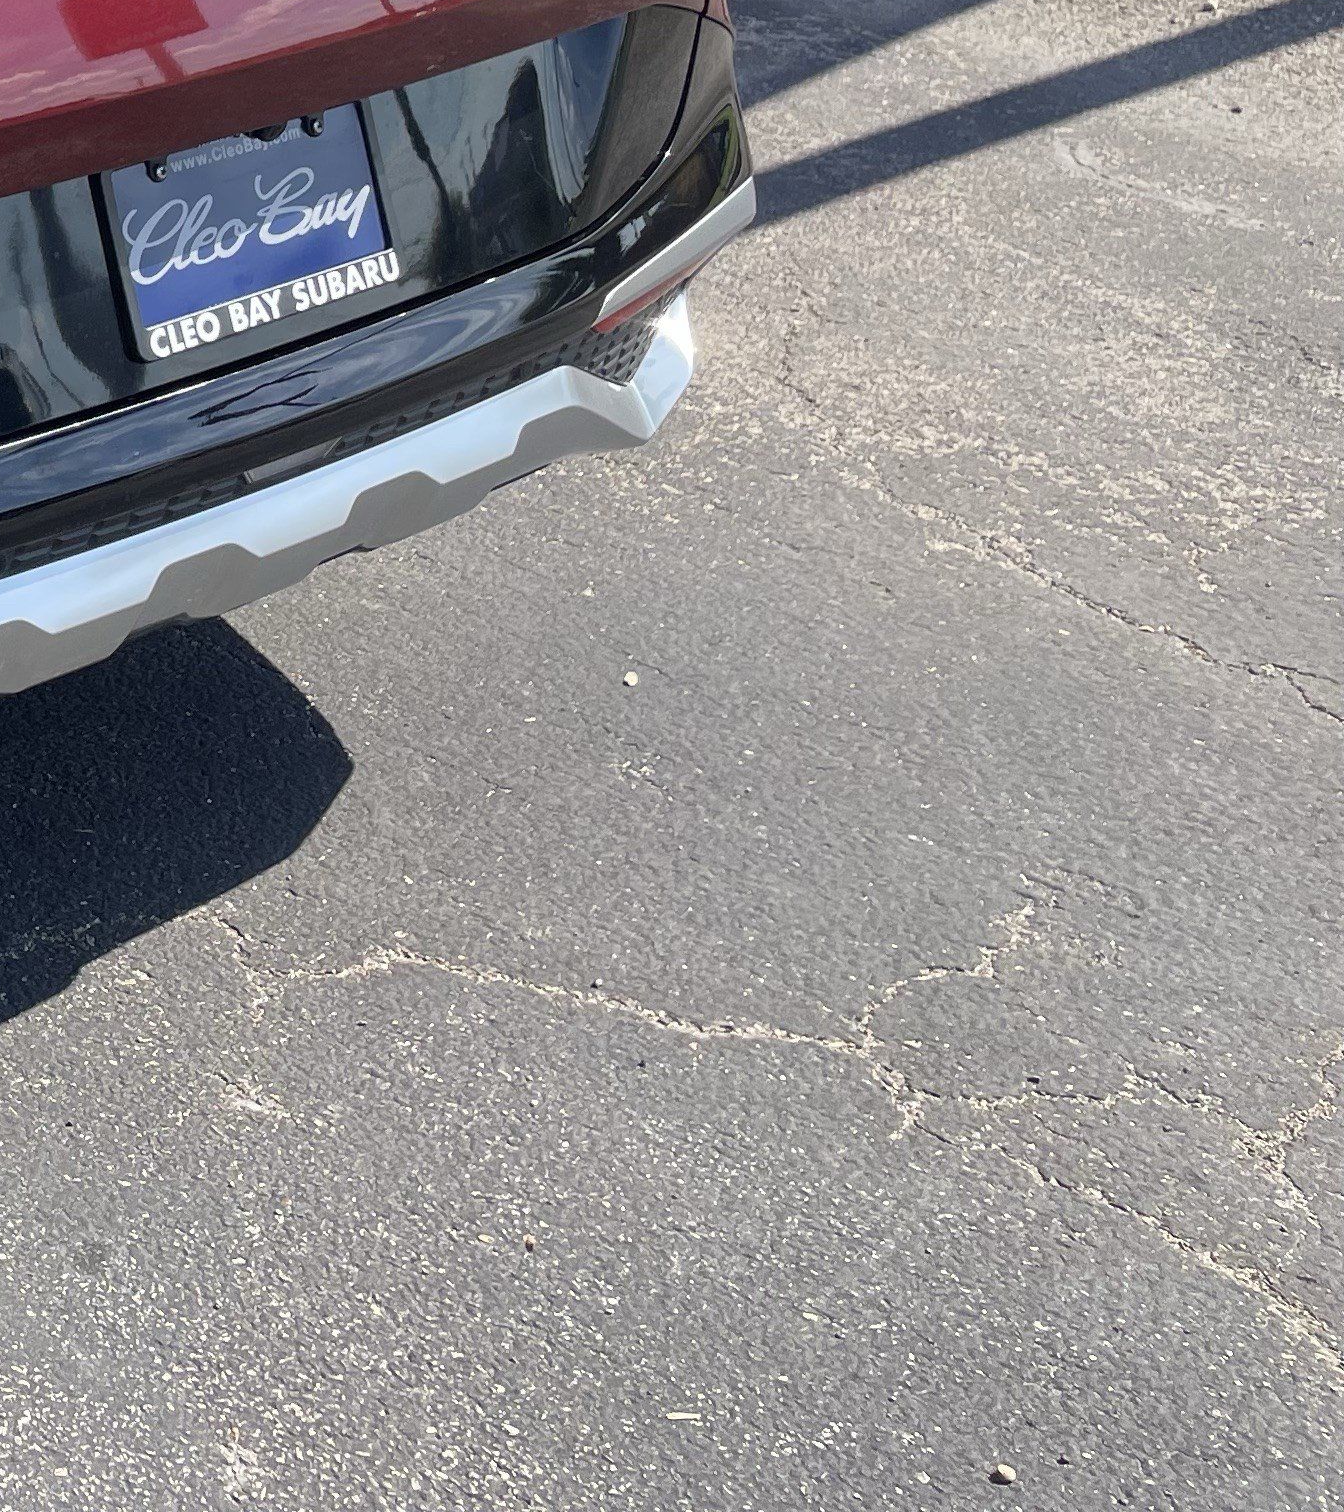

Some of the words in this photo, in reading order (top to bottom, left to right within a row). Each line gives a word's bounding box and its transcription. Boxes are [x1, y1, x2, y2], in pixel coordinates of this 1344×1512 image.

[122, 194, 258, 286] Cleo
[254, 166, 371, 245] Bay
[148, 311, 221, 358] CLEO
[228, 288, 282, 332] BAY
[291, 251, 400, 312] SUBARU
